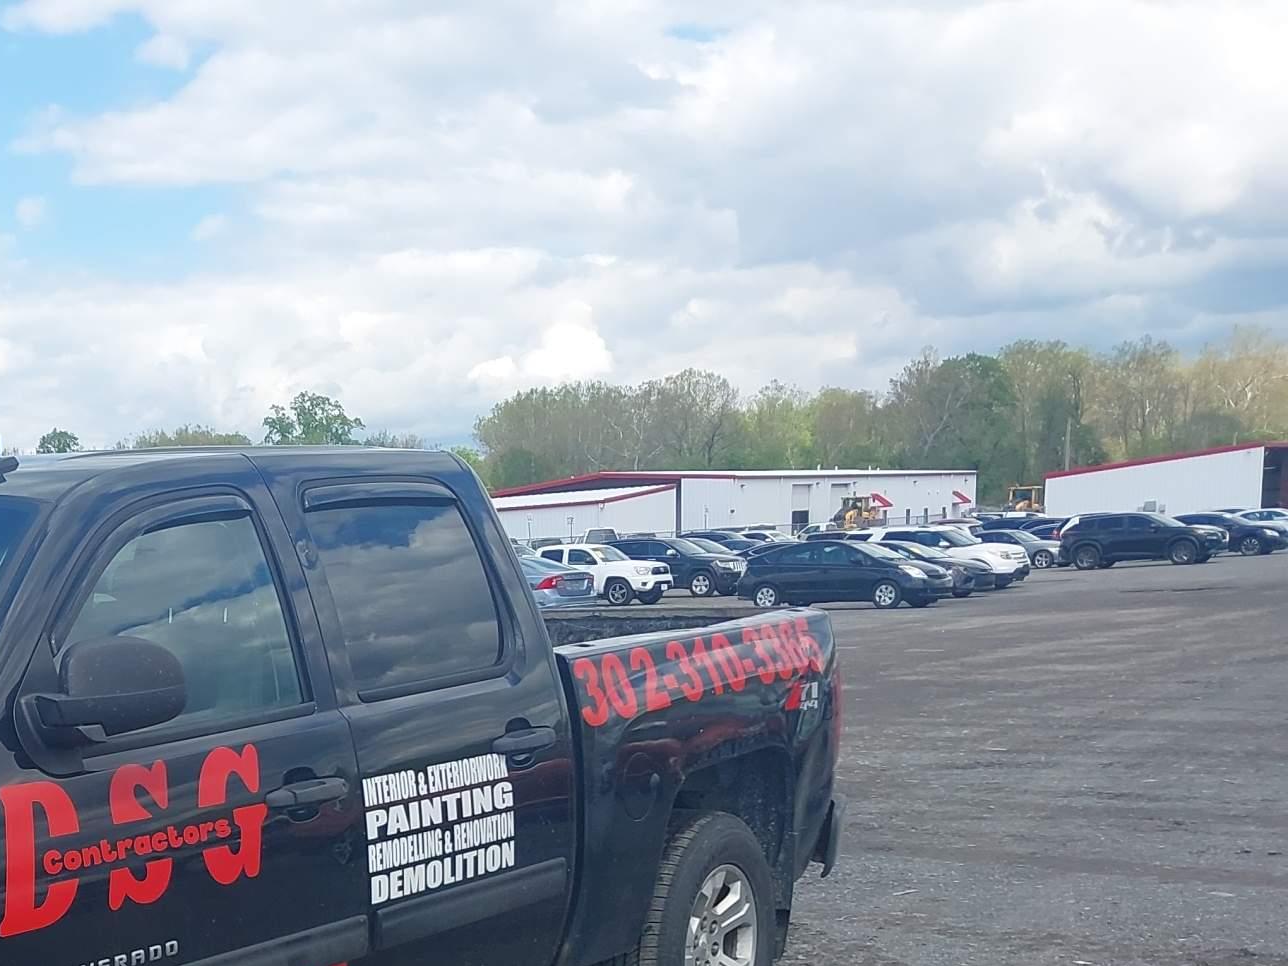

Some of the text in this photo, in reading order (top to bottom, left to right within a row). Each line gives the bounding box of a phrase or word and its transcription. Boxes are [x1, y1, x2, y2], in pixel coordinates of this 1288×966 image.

[362, 769, 418, 808] INTERIOR
[418, 772, 428, 796] &
[365, 781, 514, 841] PAINTING
[43, 818, 232, 875] Contractors
[368, 811, 515, 874] REMODELLING & RENOVATION
[371, 841, 515, 905] DEMOLITION
